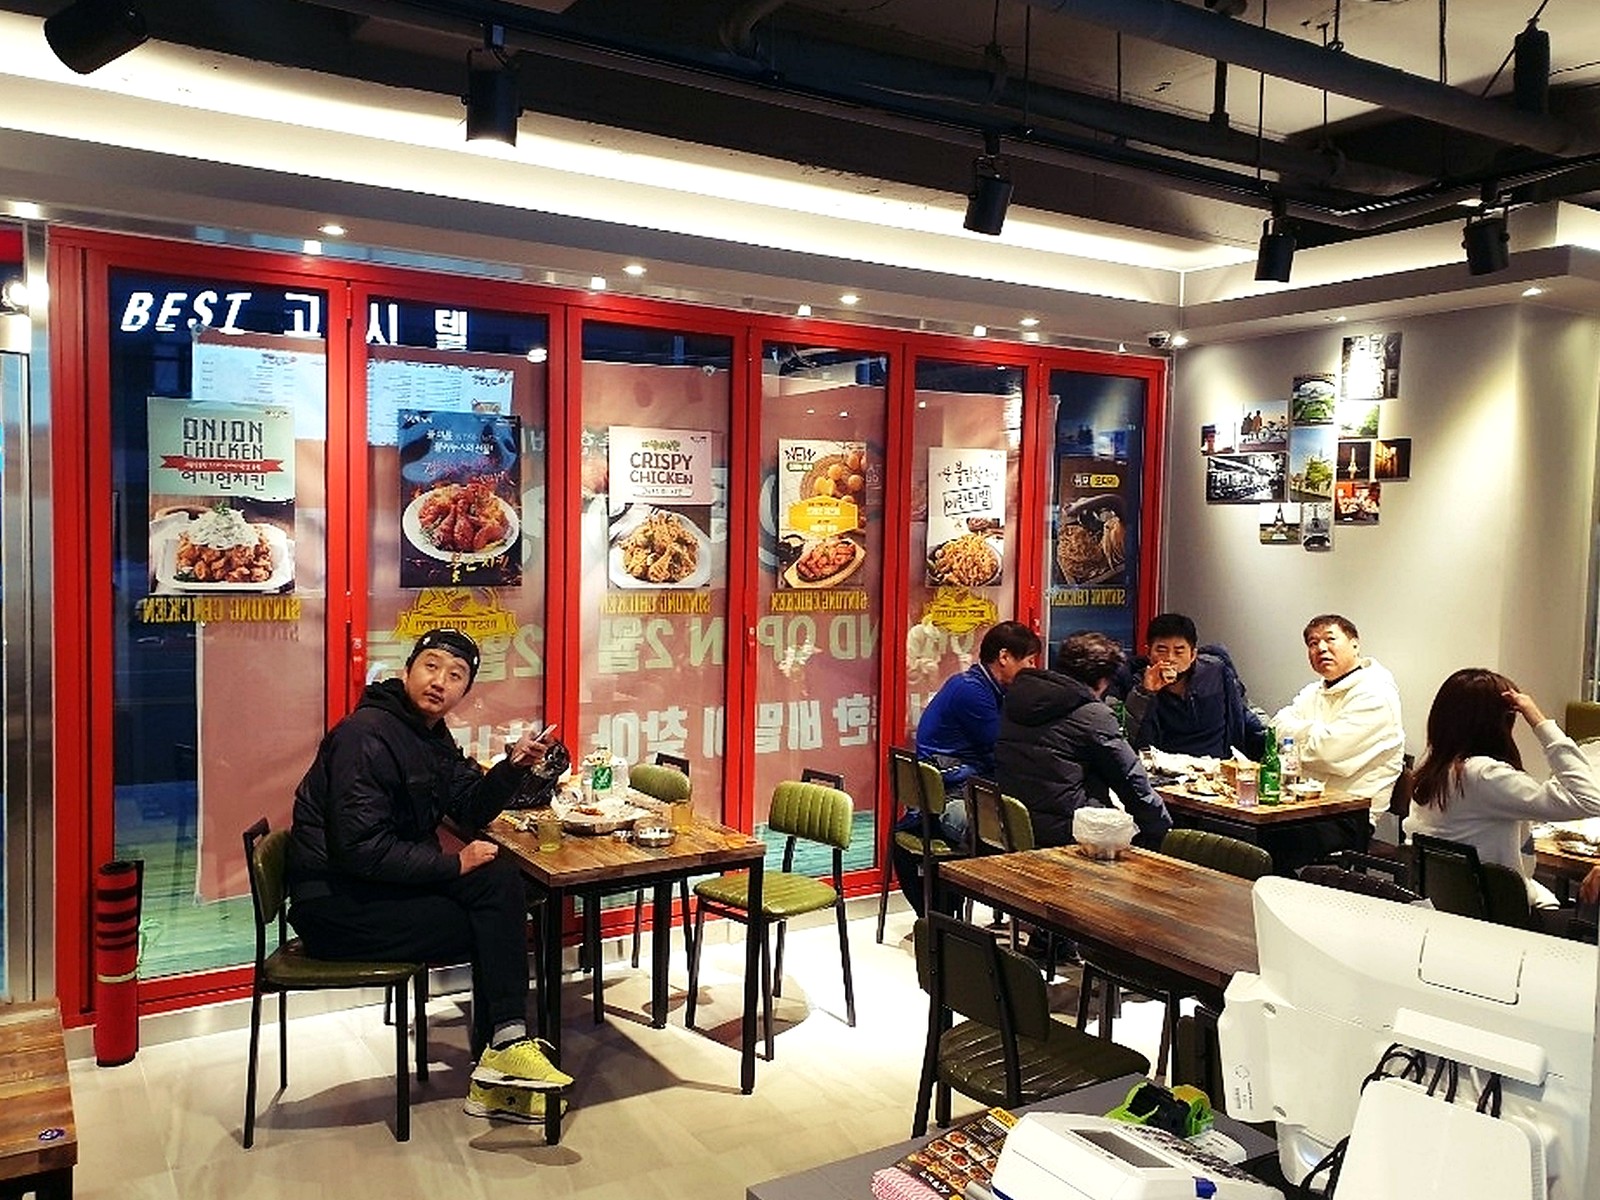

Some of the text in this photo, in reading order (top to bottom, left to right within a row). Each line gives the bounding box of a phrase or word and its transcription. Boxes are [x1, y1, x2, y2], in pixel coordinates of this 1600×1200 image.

[120, 291, 252, 335] BEST
[183, 417, 263, 443] ONION
[183, 441, 264, 460] CHICKEN
[785, 447, 816, 461] NEW
[630, 452, 693, 470] CRISPY
[181, 472, 265, 491] 어니언치킨
[630, 470, 693, 484] CHICKEN
